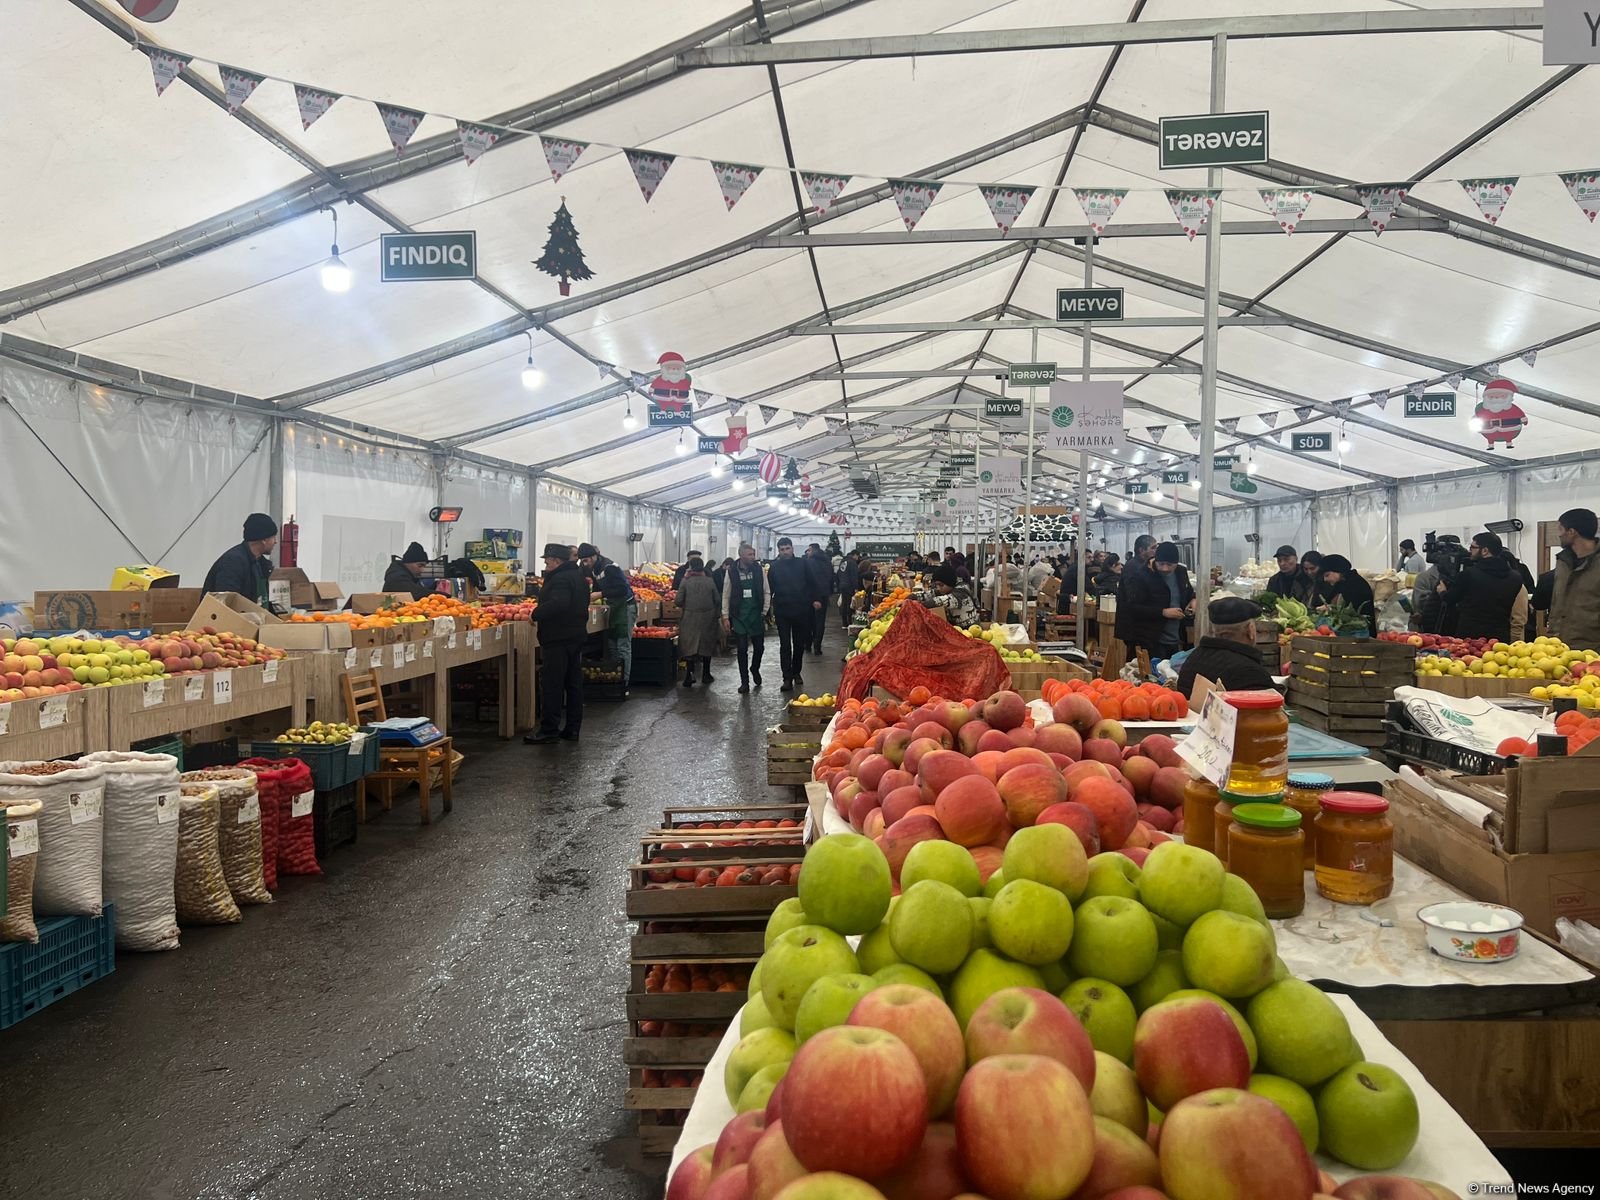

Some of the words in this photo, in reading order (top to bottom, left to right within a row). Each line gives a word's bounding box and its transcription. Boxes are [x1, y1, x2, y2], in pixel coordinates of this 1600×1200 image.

[1165, 129, 1263, 151] TƏRƏVƏZ
[389, 244, 468, 267] FINDIQ
[1061, 297, 1119, 312] MEYVƏ
[1011, 370, 1055, 380] TƏRƏVƏZ
[987, 403, 1021, 412] MEYVƏ
[1407, 400, 1453, 411] PENDİR
[1078, 420, 1122, 428] ŞƏHƏRƏ
[1056, 435, 1114, 447] YARMARKA
[1299, 437, 1324, 449] SÜD
[1168, 473, 1184, 482] YAĞ
[216, 680, 230, 693] 112
